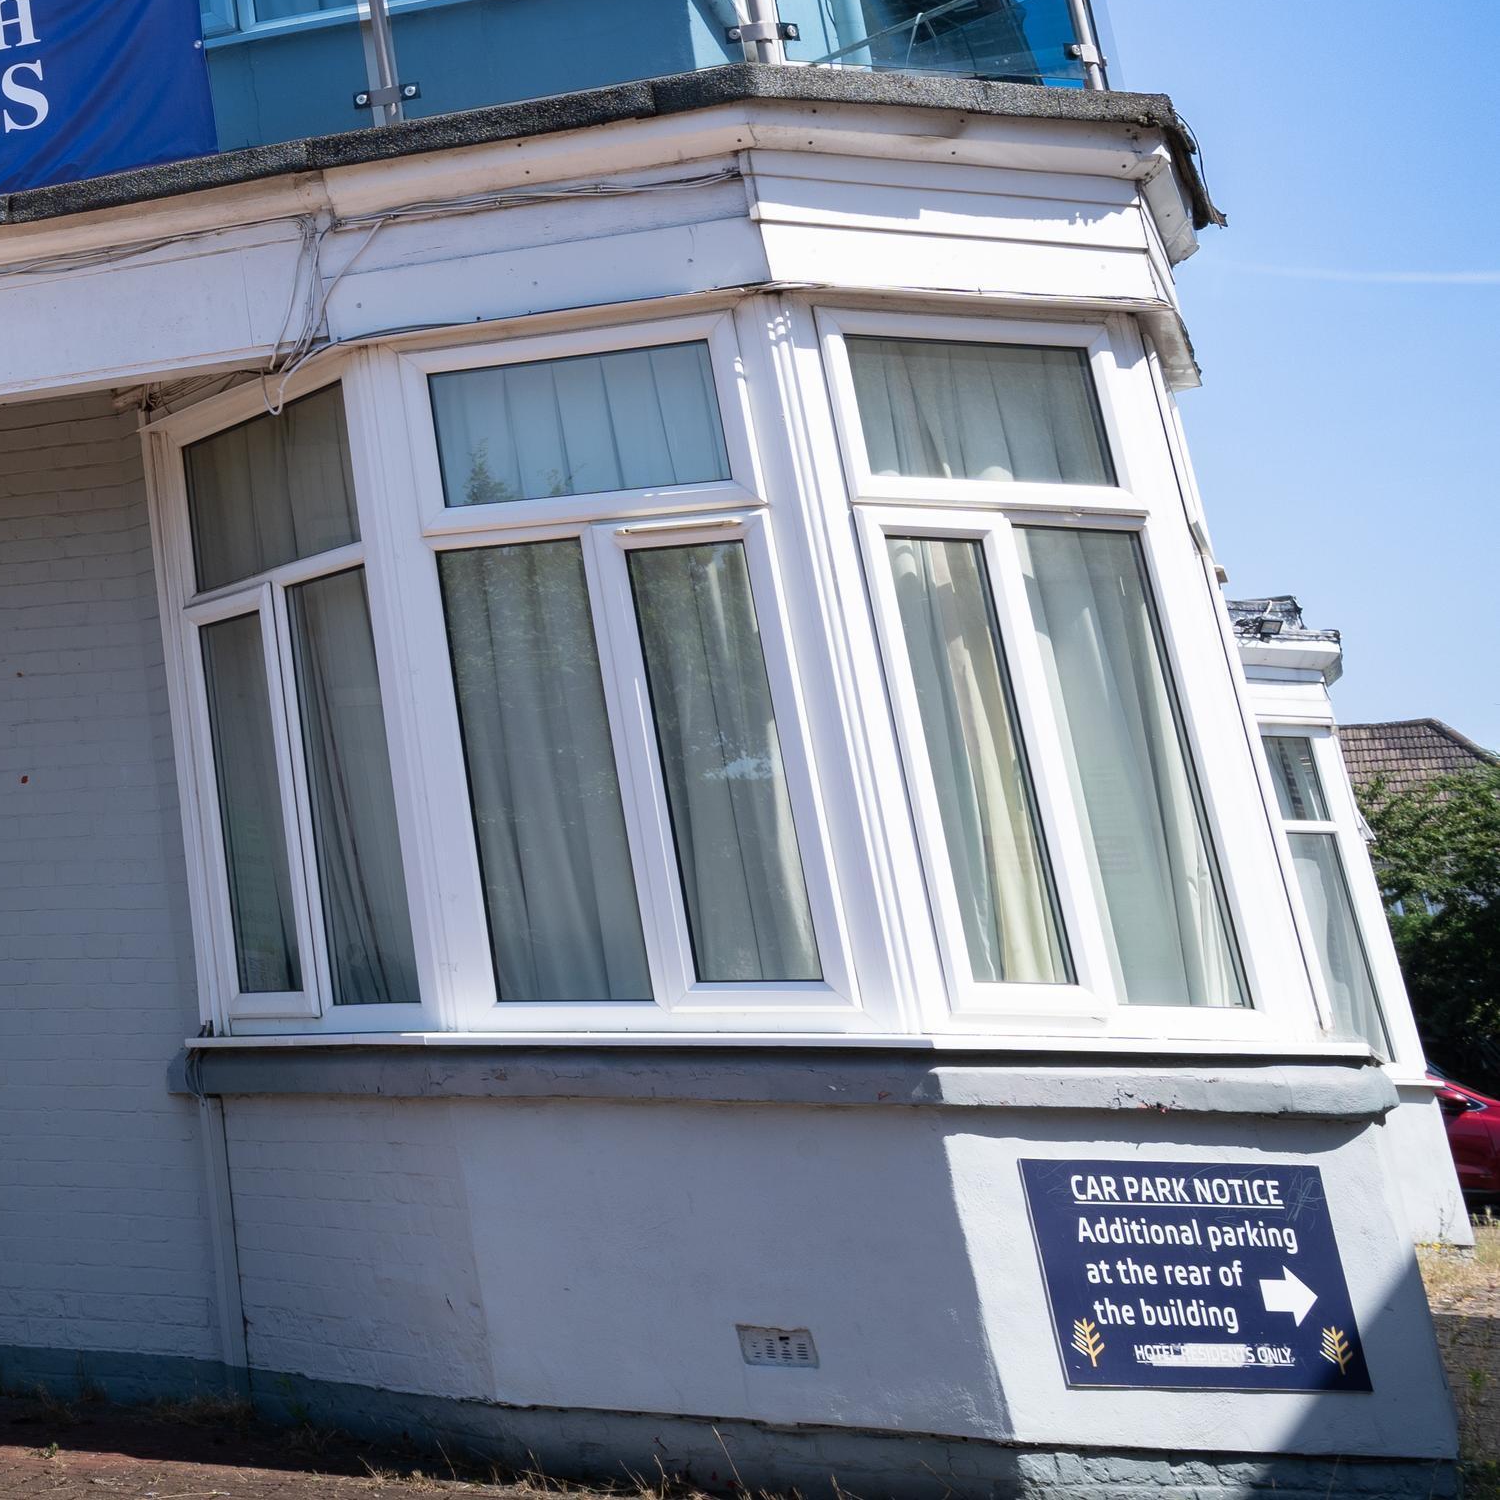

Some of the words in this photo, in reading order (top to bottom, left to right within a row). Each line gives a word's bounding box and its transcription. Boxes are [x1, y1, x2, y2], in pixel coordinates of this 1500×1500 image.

[1070, 1174, 1121, 1201] CAR
[1122, 1176, 1191, 1202] PARK
[1193, 1178, 1284, 1205] NOTICE
[1077, 1216, 1203, 1246] Additional
[1206, 1220, 1299, 1255] parking
[1085, 1259, 1113, 1285] at
[1115, 1257, 1158, 1285] the
[1163, 1264, 1212, 1286] rear
[1218, 1259, 1243, 1287] of
[1092, 1297, 1136, 1326] the
[1139, 1297, 1240, 1334] building
